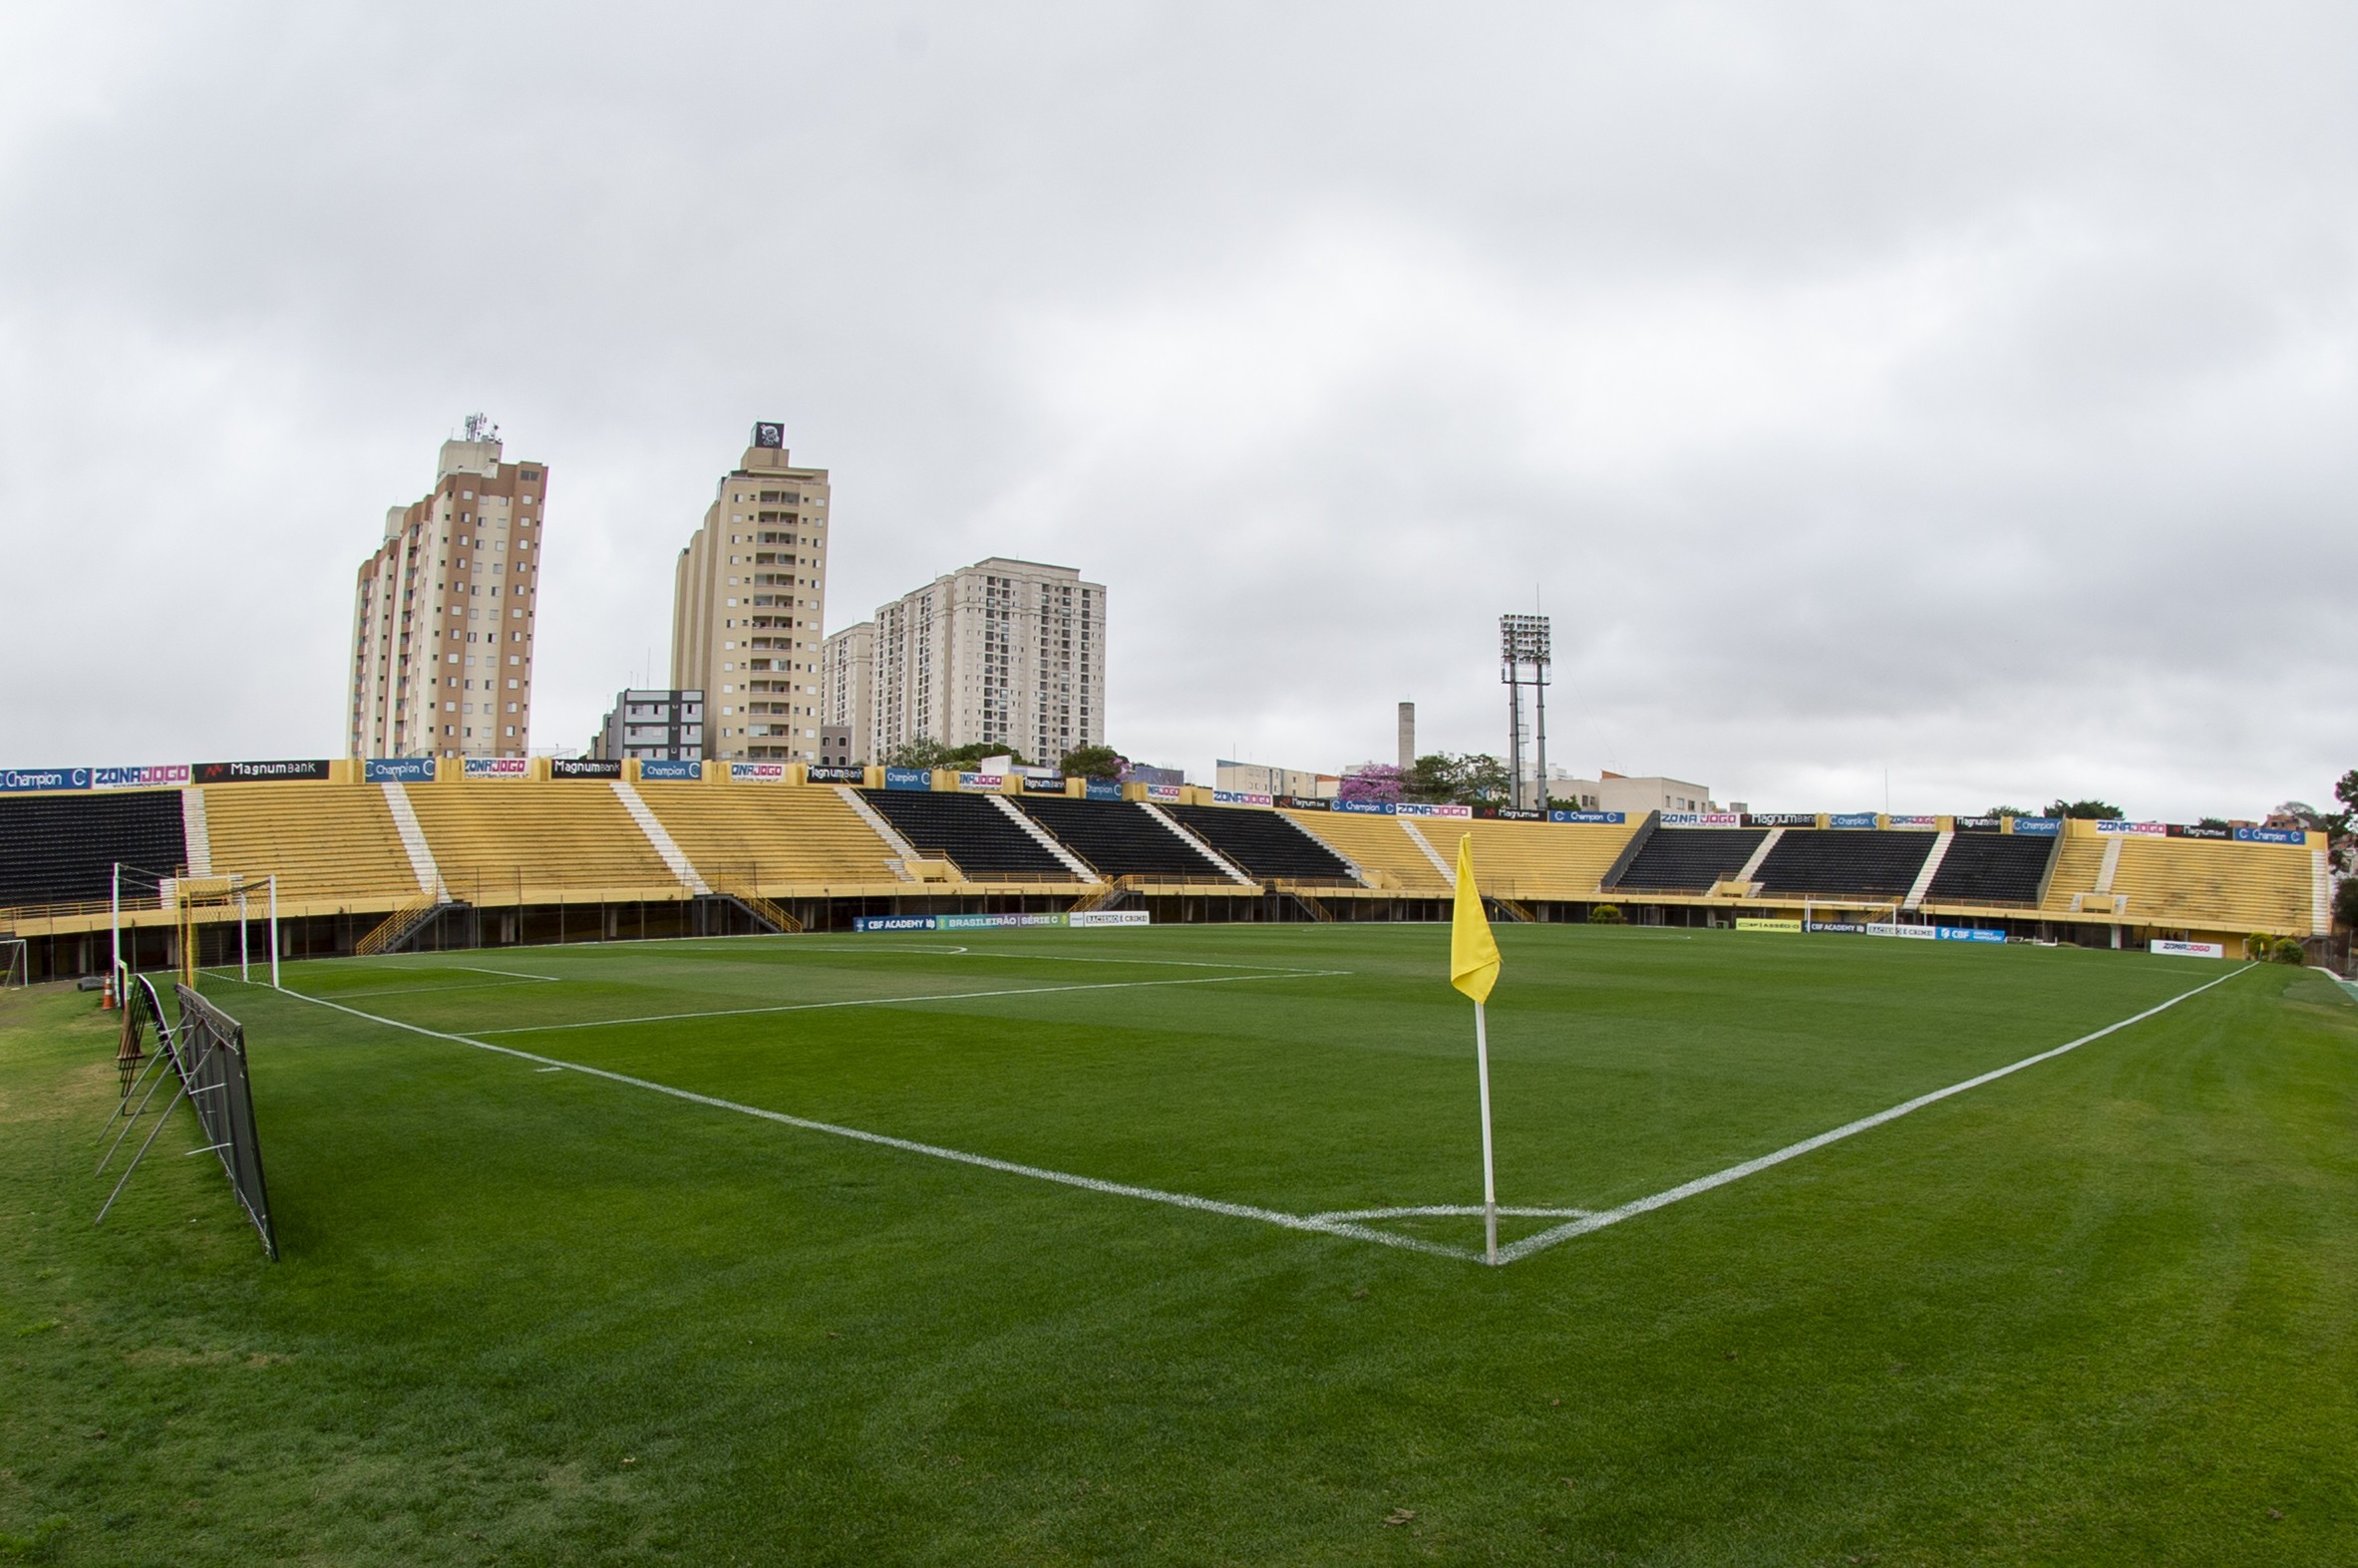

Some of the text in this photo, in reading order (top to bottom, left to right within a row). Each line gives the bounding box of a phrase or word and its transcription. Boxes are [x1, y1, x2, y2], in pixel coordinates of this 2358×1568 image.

[376, 763, 420, 777] Champion
[647, 766, 685, 778] Champion
[6, 771, 62, 788] Champion
[886, 772, 918, 784] Champion
[1346, 800, 1381, 812] Champion
[1570, 811, 1604, 822] Champion
[1838, 815, 1868, 826] Champion
[2022, 820, 2055, 830] Champion
[2252, 829, 2286, 842] Champion
[884, 919, 923, 929] ACADEMY
